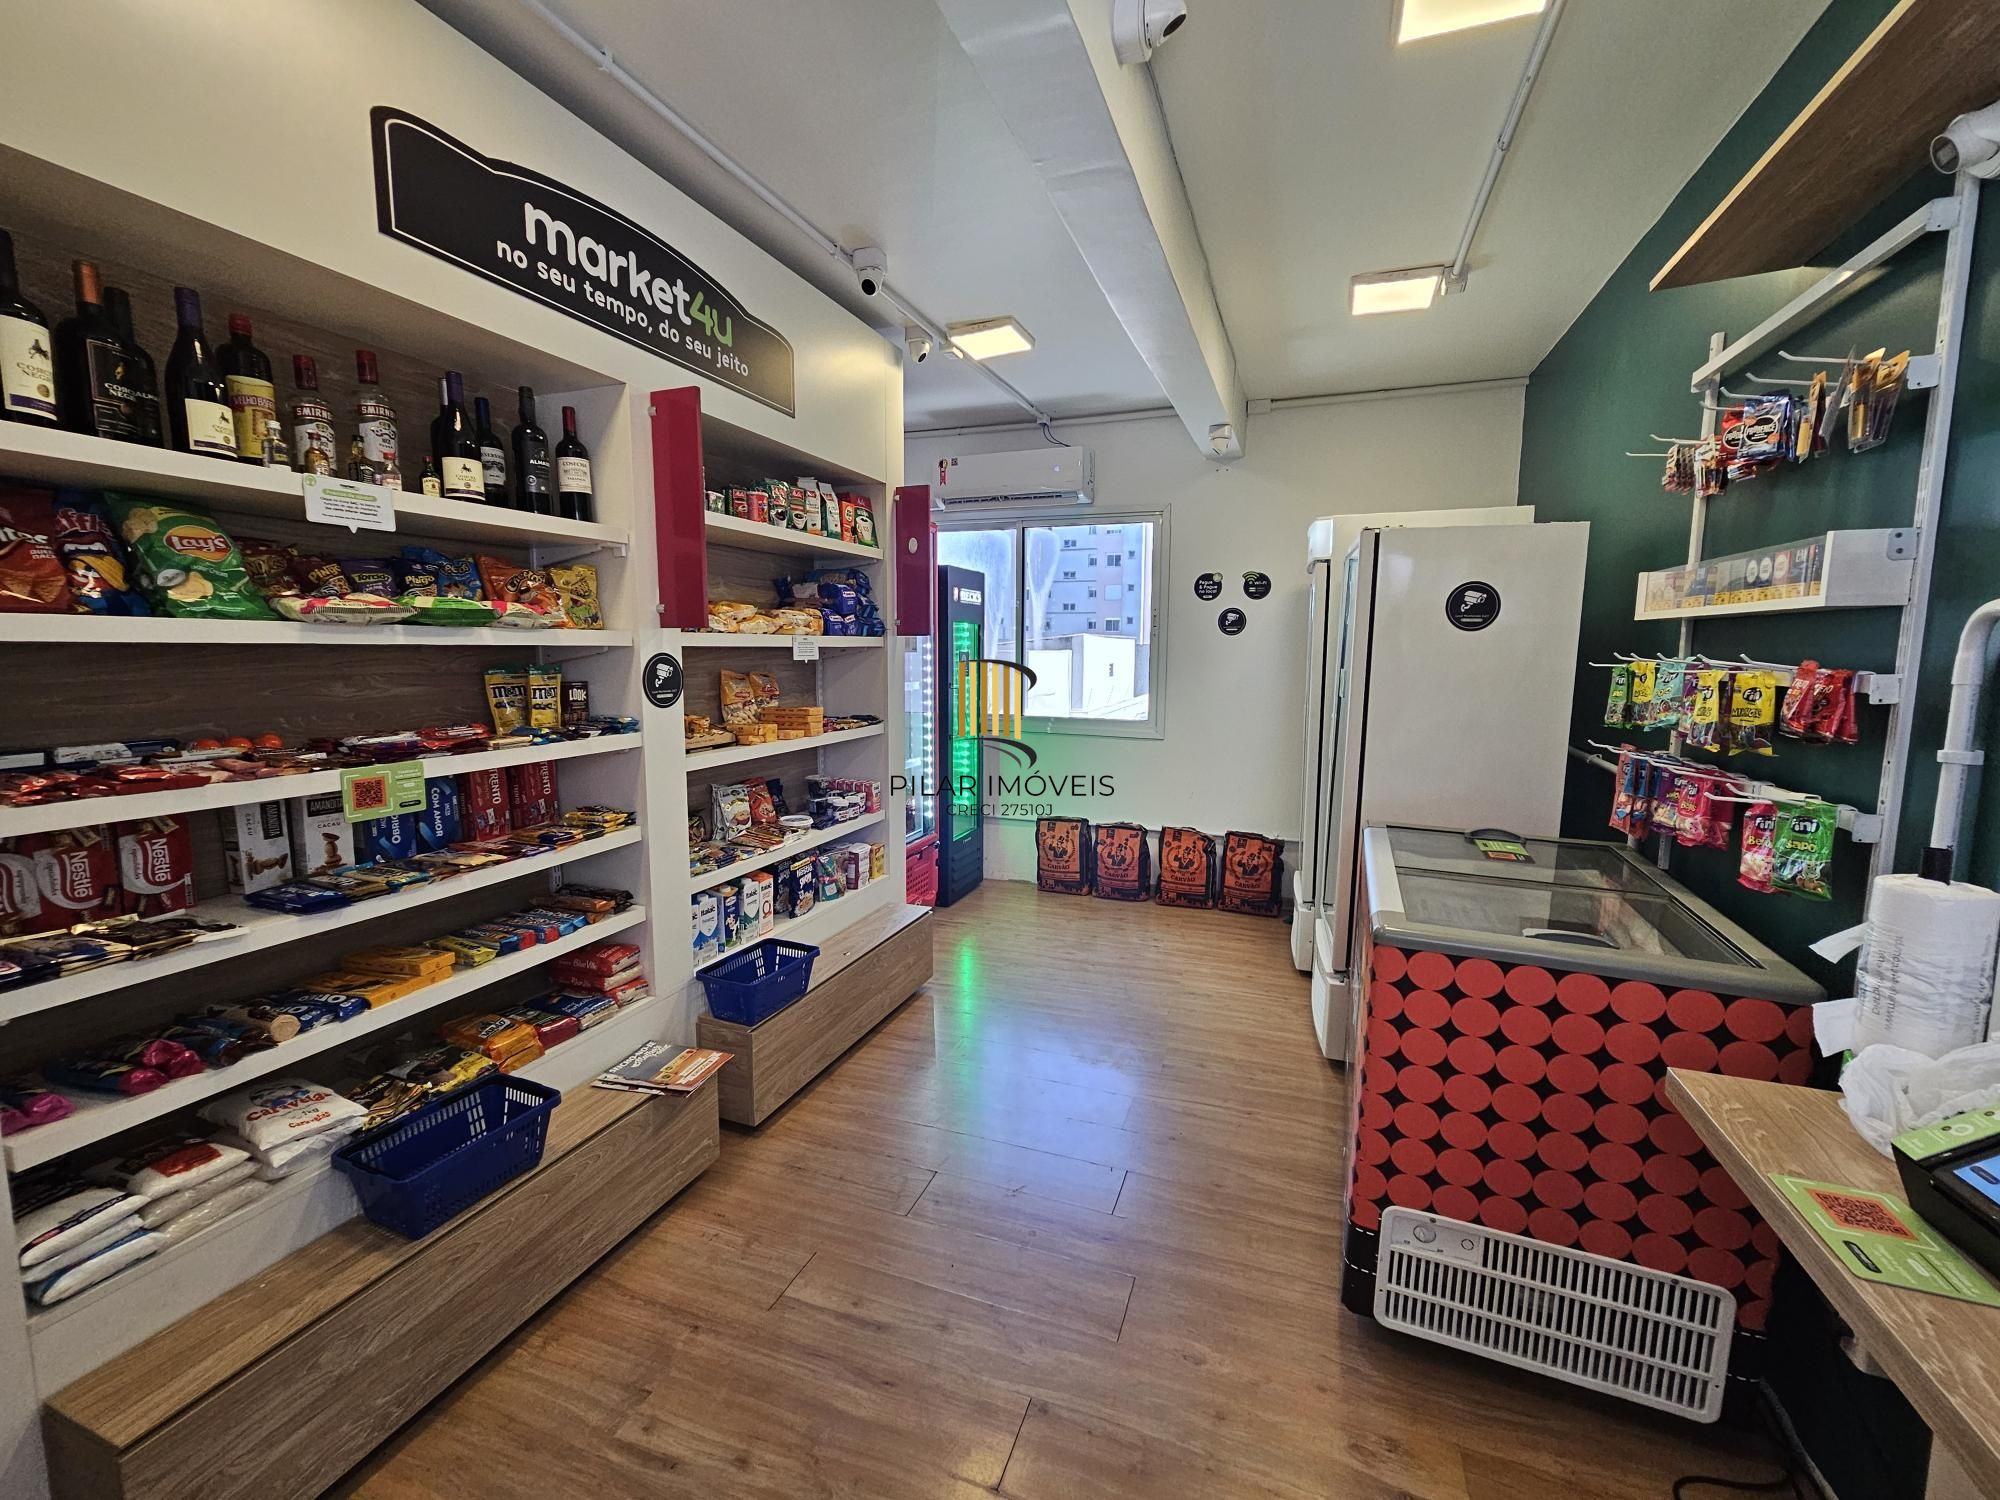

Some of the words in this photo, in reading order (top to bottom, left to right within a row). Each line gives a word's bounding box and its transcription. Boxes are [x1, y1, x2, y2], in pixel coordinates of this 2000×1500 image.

[524, 202, 733, 348] market4u
[496, 239, 529, 269] no
[536, 261, 577, 294] seu
[583, 280, 653, 334] tempo,
[658, 319, 680, 343] do
[685, 335, 712, 360] seu
[716, 346, 749, 377] jeito
[170, 536, 227, 553] Lay's
[568, 688, 587, 701] LOOK
[488, 769, 502, 804] TRENTO
[541, 762, 552, 795] TRENTO
[431, 787, 440, 809] COM
[317, 821, 341, 829] CACAU
[433, 810, 444, 837] AMOR
[1791, 818, 1819, 833] Fini
